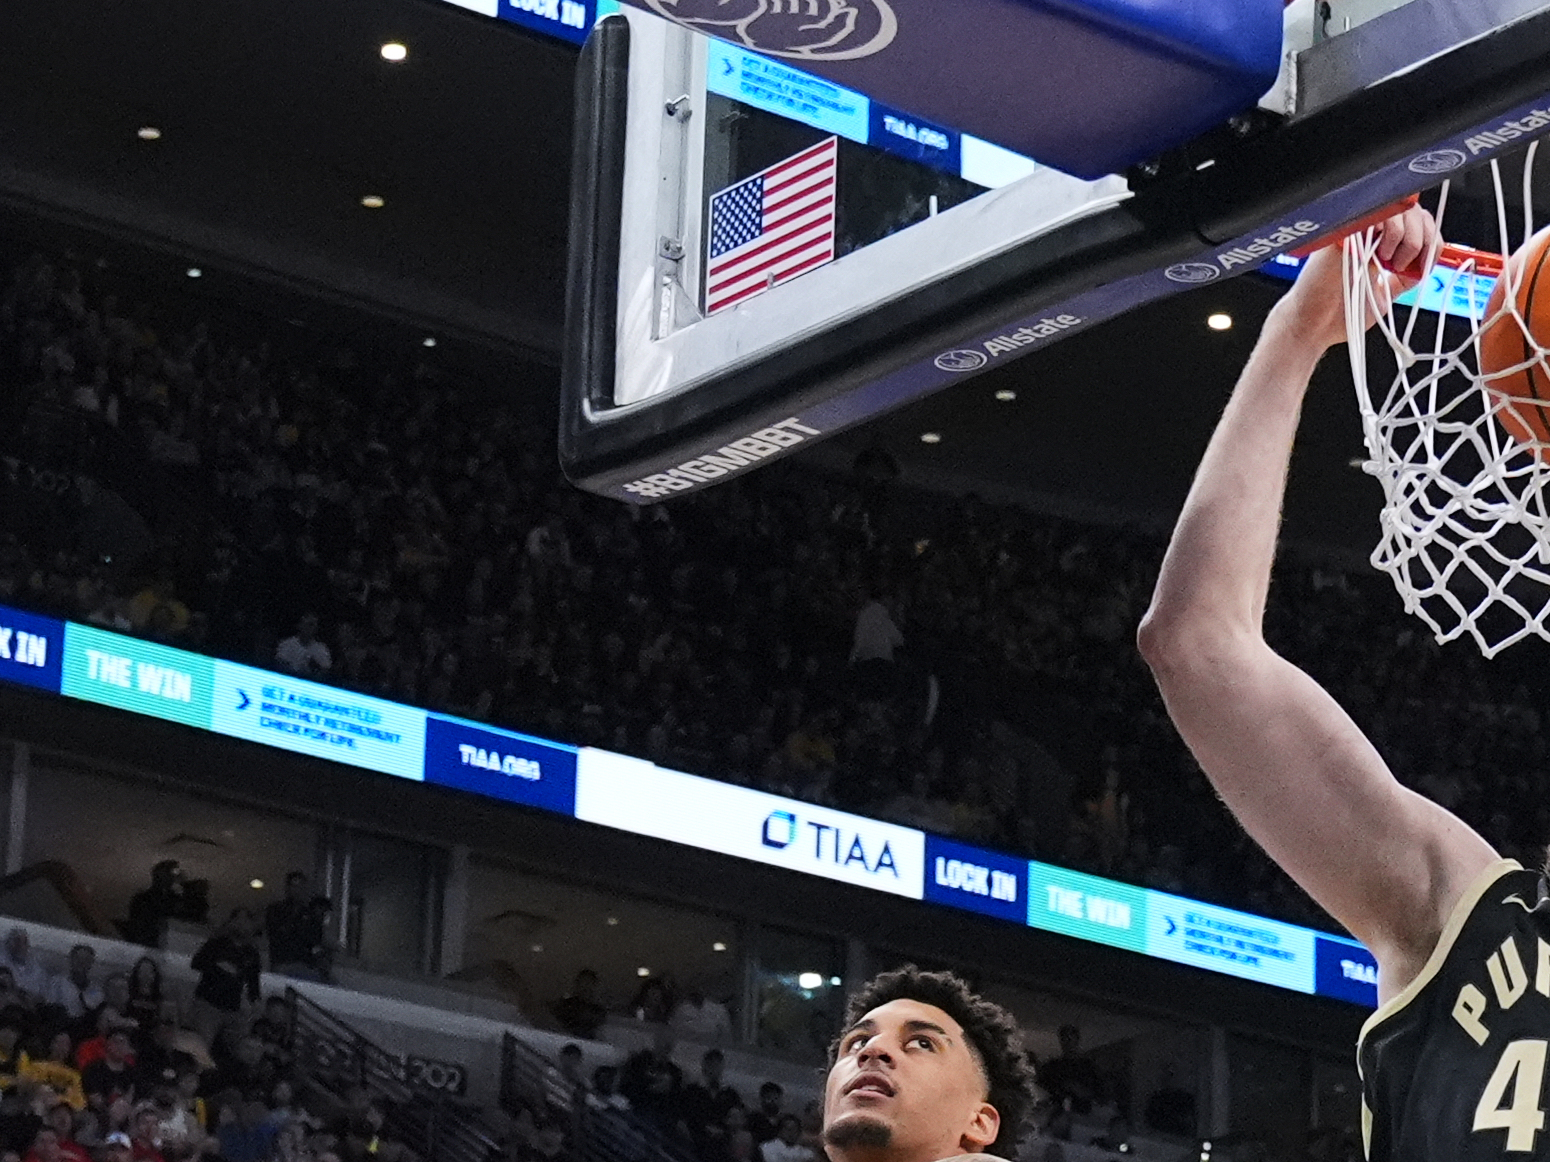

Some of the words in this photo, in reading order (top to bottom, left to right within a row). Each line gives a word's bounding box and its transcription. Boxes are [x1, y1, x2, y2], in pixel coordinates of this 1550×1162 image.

[1216, 217, 1321, 270] Allstate
[982, 312, 1083, 358] Allstate
[15, 630, 47, 667] IN
[86, 649, 133, 688] THE
[137, 661, 192, 703] WIN
[807, 820, 900, 879] TIAA
[935, 856, 989, 896] LOCK
[991, 870, 1017, 902] IN
[1046, 885, 1084, 919] THE
[1085, 895, 1132, 930] WIN
